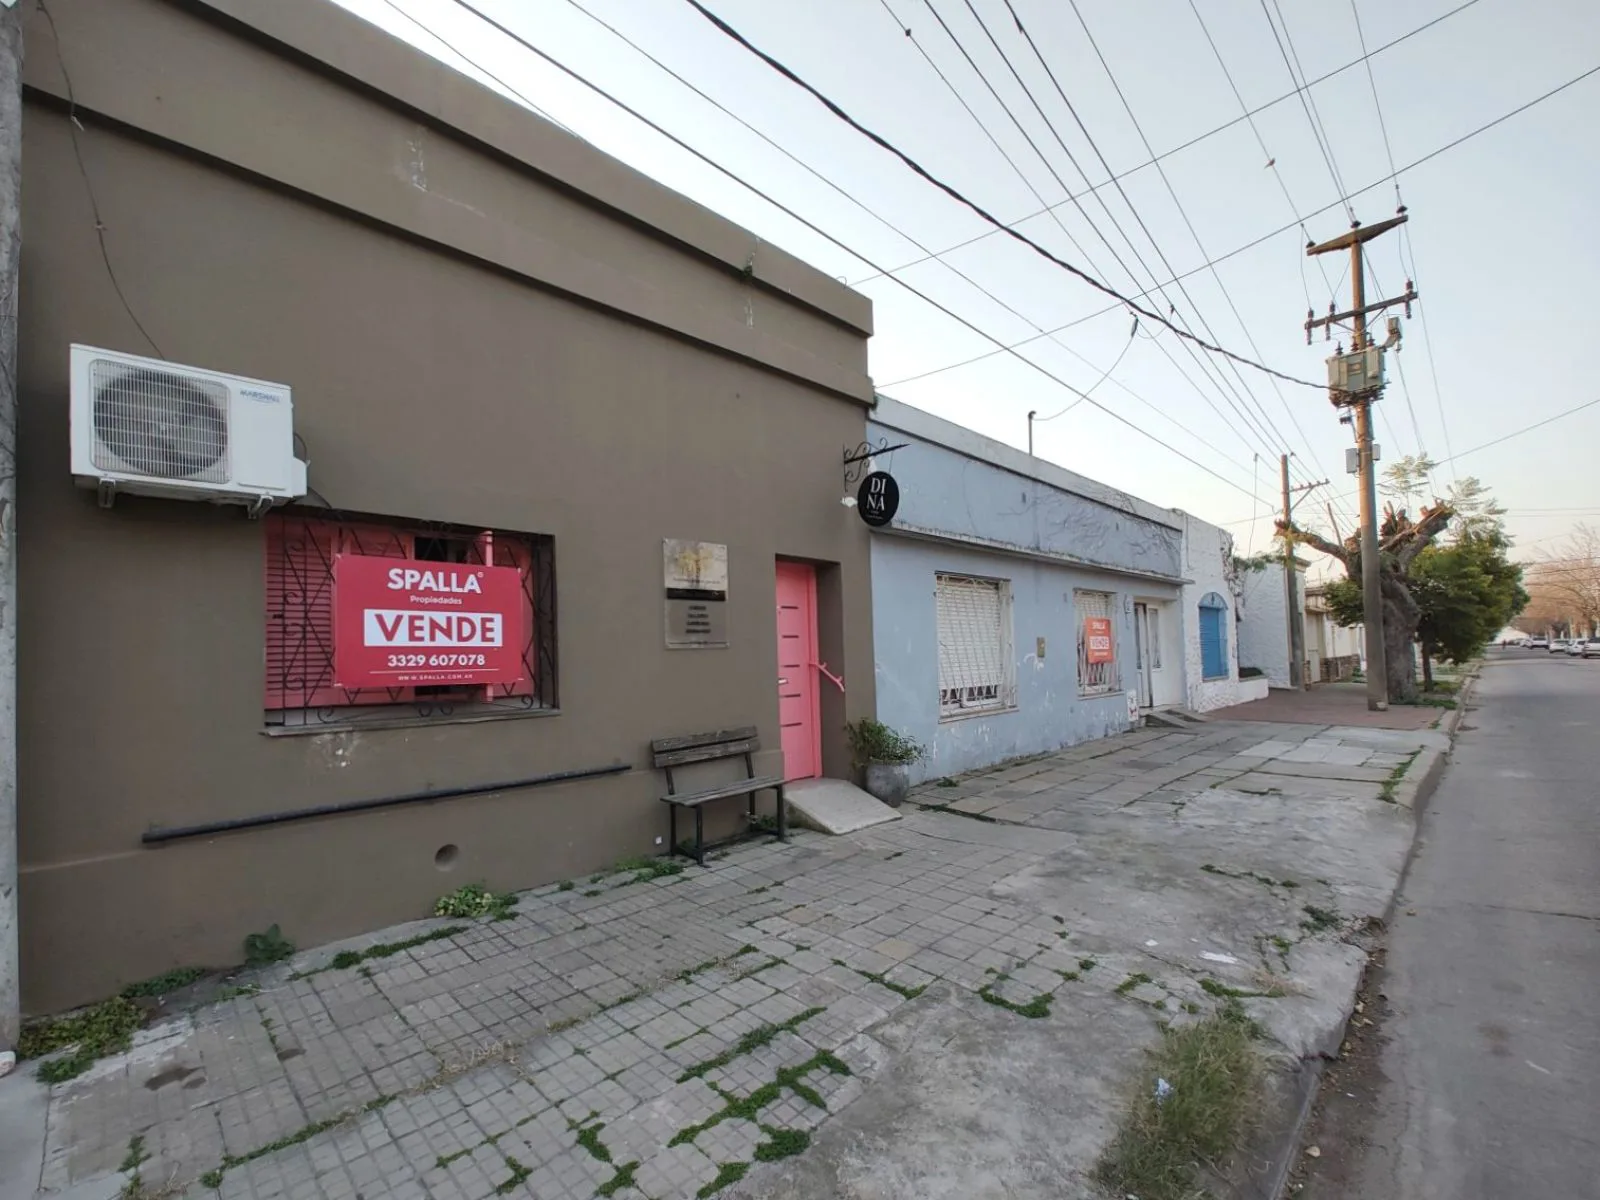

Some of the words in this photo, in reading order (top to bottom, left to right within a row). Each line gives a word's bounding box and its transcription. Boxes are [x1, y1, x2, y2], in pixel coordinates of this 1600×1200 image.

[871, 477, 886, 494] DI
[866, 494, 885, 511] NA
[387, 568, 482, 594] SPALLA
[409, 595, 463, 606] Propiedades
[374, 613, 496, 643] VENDE
[387, 654, 426, 667] 3329
[428, 653, 486, 667] 607078
